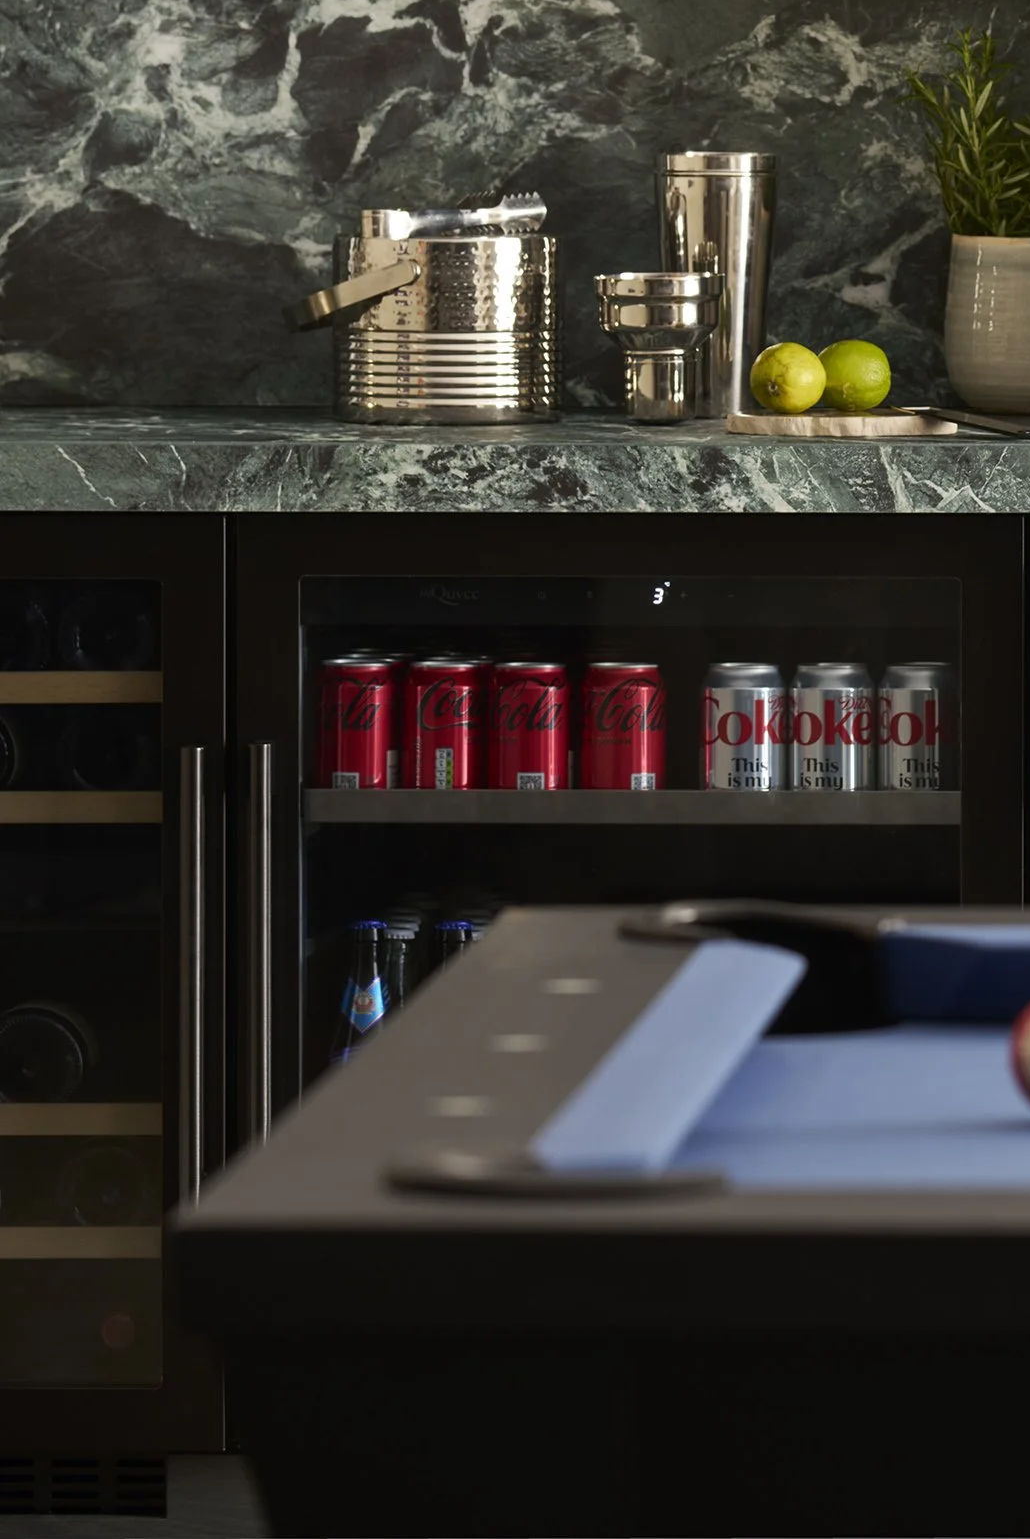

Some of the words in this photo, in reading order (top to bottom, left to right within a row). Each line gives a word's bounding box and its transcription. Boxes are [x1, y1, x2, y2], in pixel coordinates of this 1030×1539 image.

[730, 757, 769, 773] This
[803, 757, 840, 773] This
[902, 757, 941, 773] This
[728, 772, 742, 788] is
[745, 774, 773, 790] my
[800, 772, 812, 789] is
[815, 774, 843, 791] my
[899, 772, 913, 789] is
